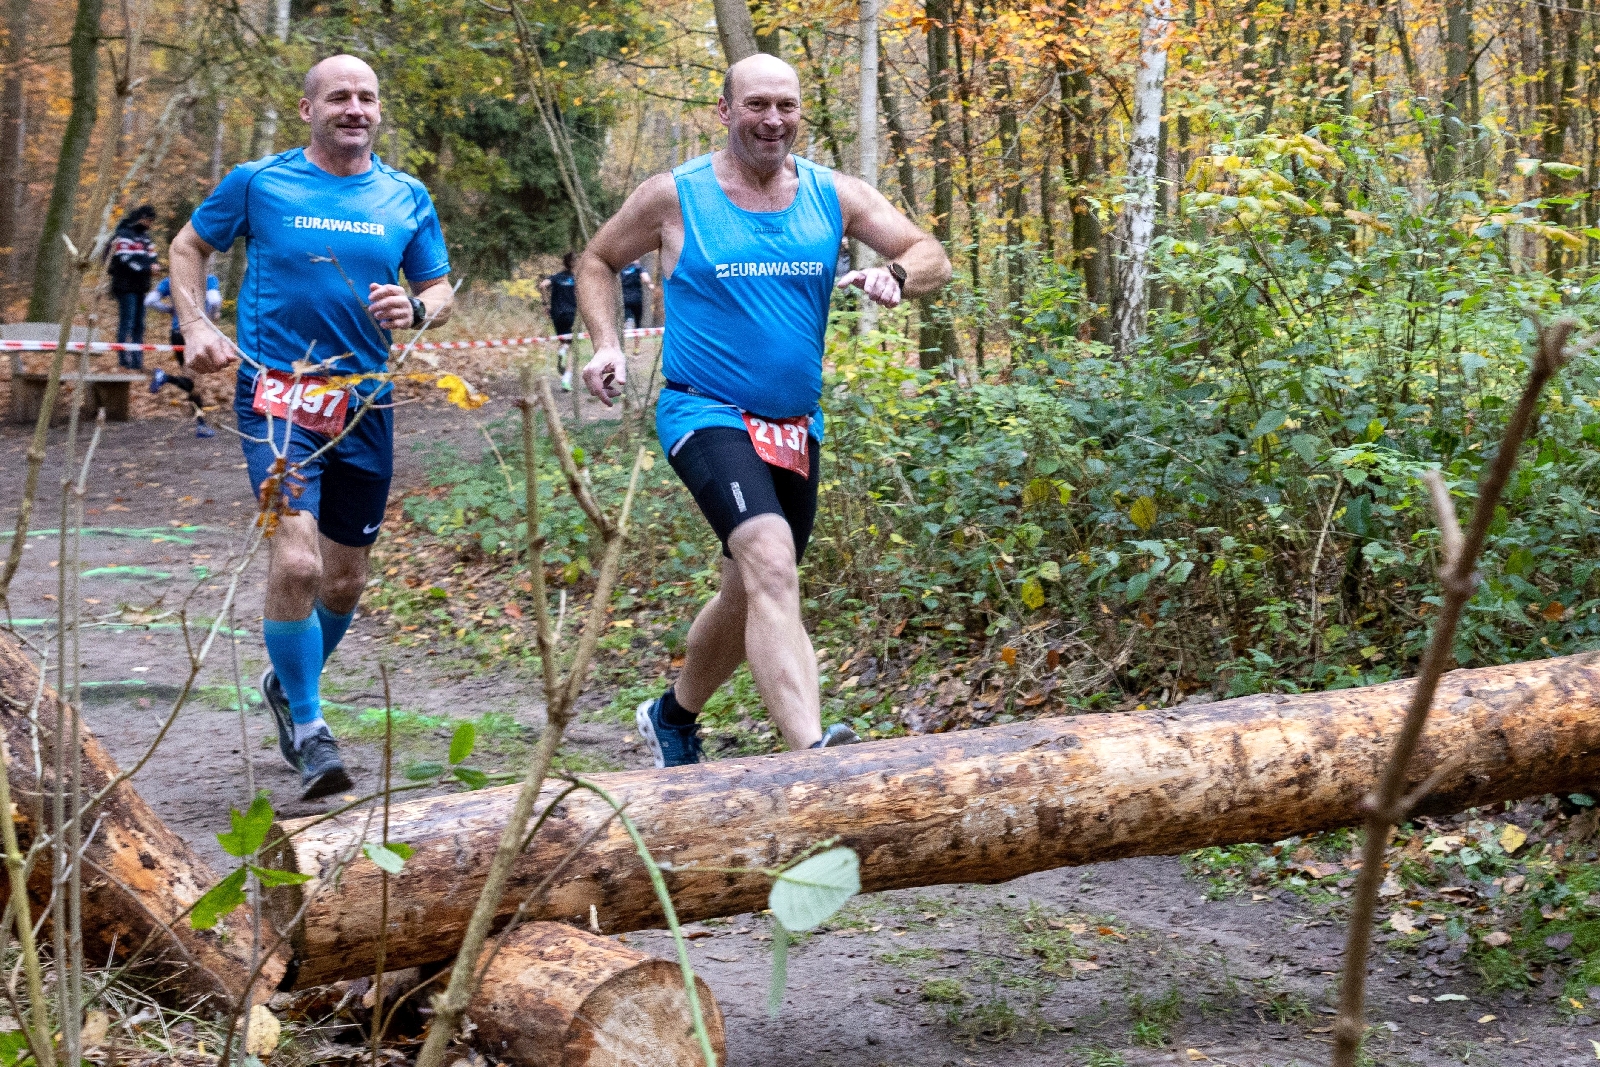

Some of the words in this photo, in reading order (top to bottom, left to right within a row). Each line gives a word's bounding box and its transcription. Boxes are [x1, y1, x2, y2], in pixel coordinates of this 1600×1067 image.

[294, 215, 385, 236] EURAWASSER
[730, 261, 823, 277] EURAWASSER
[750, 418, 808, 455] 2137
